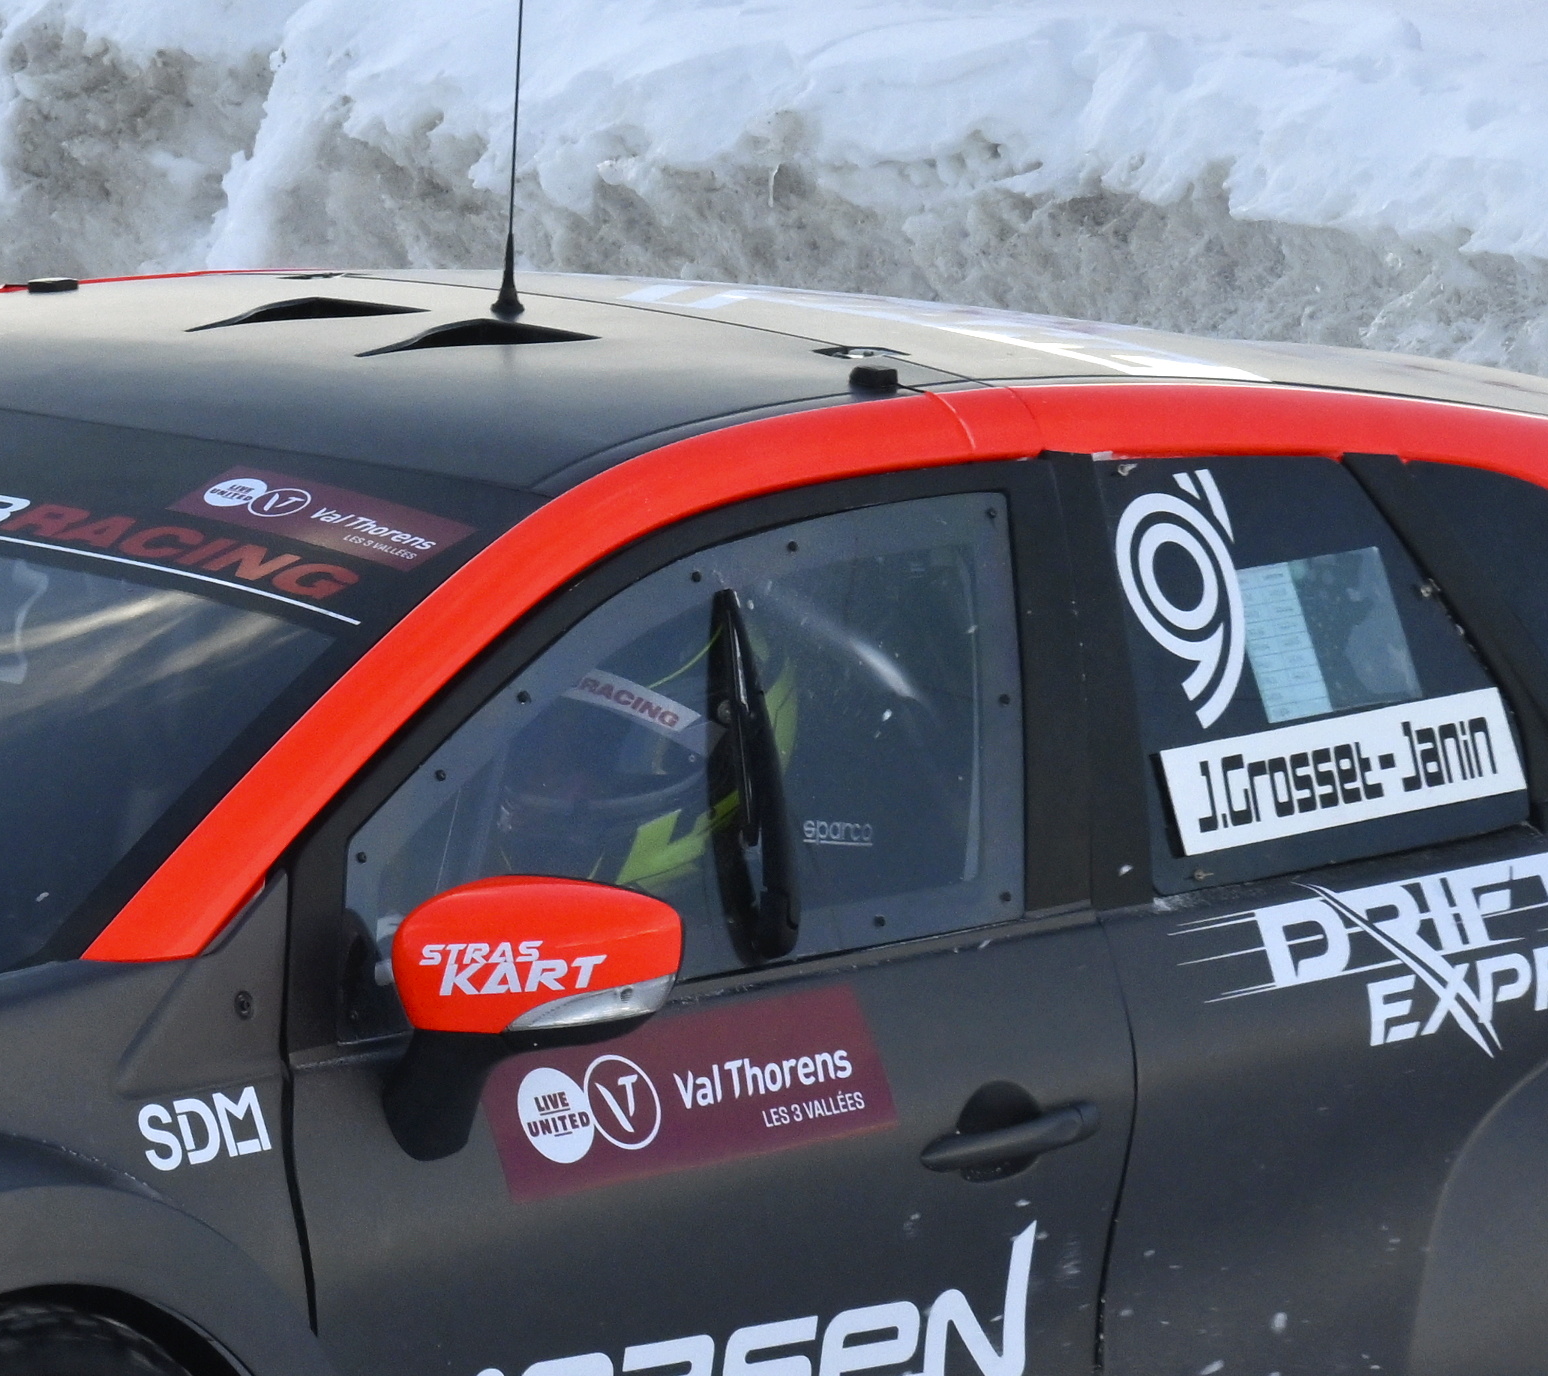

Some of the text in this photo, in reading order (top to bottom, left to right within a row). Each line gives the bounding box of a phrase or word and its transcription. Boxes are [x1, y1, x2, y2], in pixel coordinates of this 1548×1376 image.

[310, 506, 355, 525] Val
[348, 515, 437, 551] Thorens
[342, 533, 365, 545] LES
[4, 503, 360, 600] RACING
[575, 677, 681, 728] RACING
[802, 819, 873, 844] sparco
[419, 940, 544, 966] STRAS
[439, 954, 608, 997] KART
[672, 1064, 723, 1110] Val
[724, 1049, 853, 1098] Thorens
[533, 1091, 570, 1113] LIVE
[760, 1090, 866, 1128] LES 3 VALLÉES
[527, 1111, 591, 1138] UNITED
